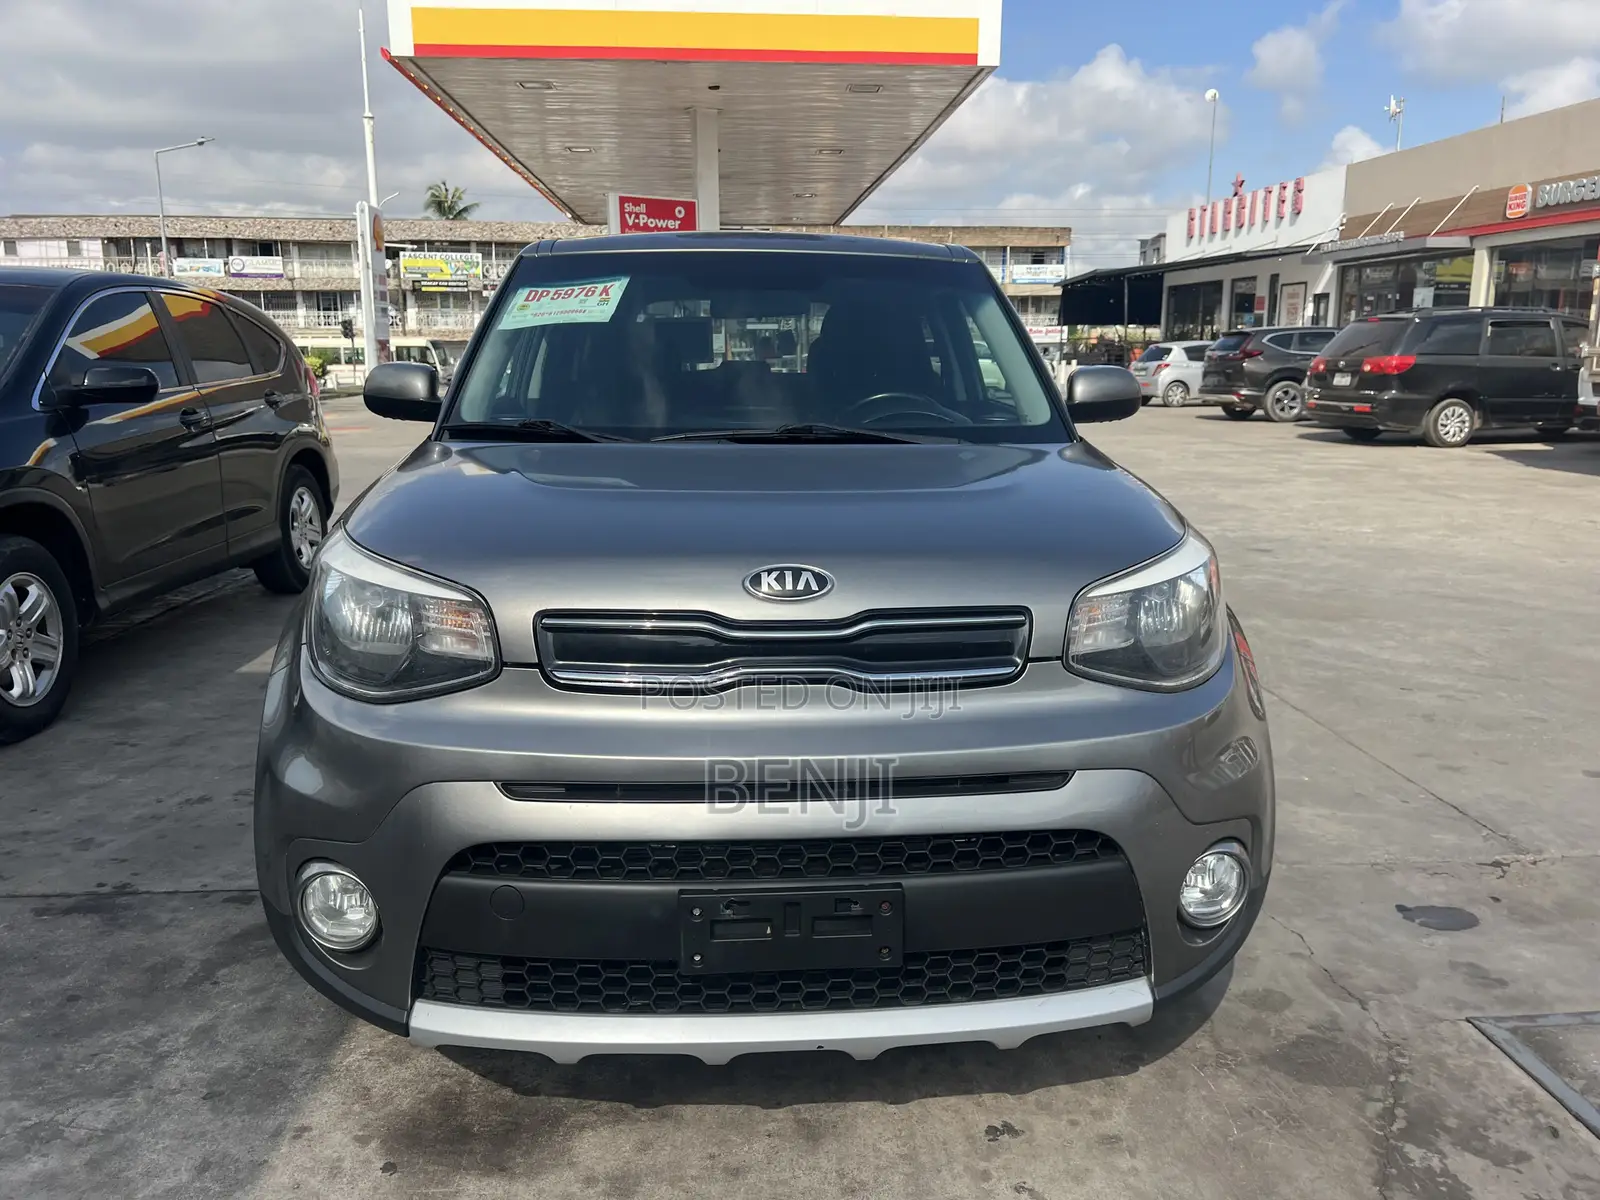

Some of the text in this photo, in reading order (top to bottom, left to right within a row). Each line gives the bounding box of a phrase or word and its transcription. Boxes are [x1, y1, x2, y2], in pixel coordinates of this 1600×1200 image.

[1536, 176, 1600, 208] BURGE
[624, 202, 646, 213] Shell
[1508, 201, 1526, 211] KING
[625, 213, 681, 229] V-Power
[524, 283, 615, 302] DP 5976 K
[760, 570, 819, 590] KIA
